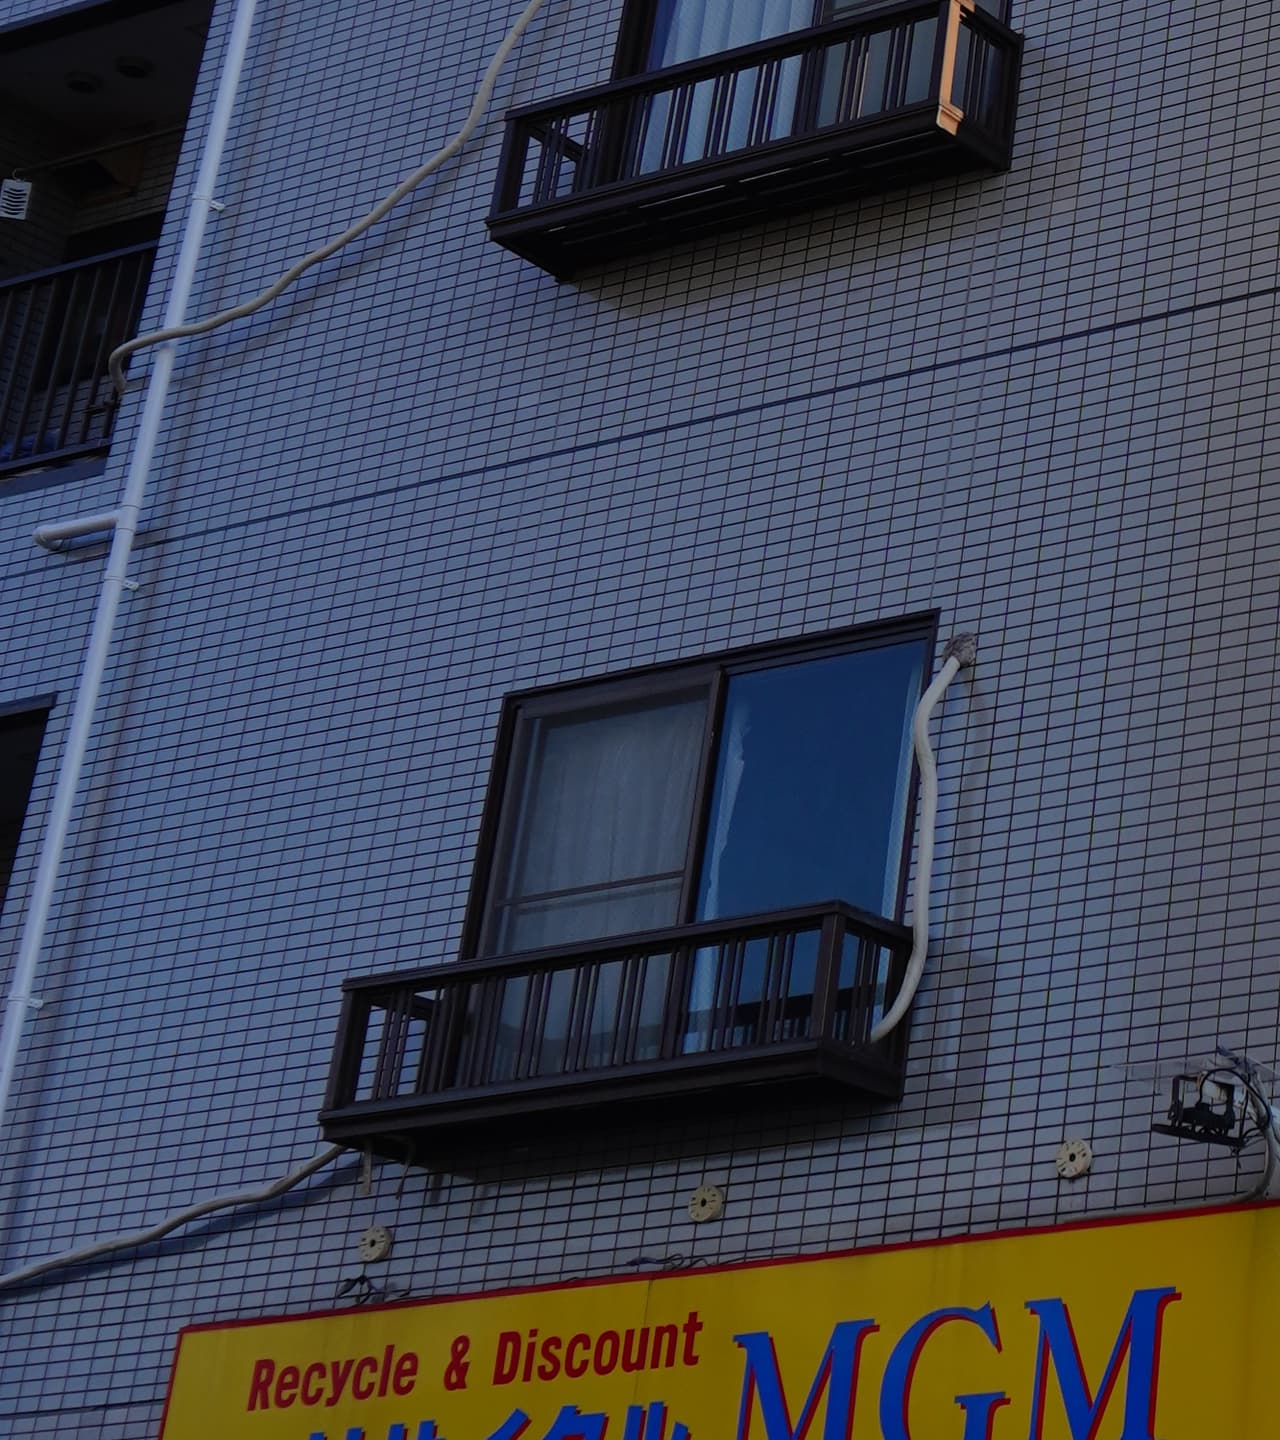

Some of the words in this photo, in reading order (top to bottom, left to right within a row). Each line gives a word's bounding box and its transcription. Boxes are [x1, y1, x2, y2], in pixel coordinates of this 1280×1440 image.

[246, 1343, 420, 1412] Recycle
[444, 1335, 471, 1391] &
[493, 1311, 704, 1386] Discount
